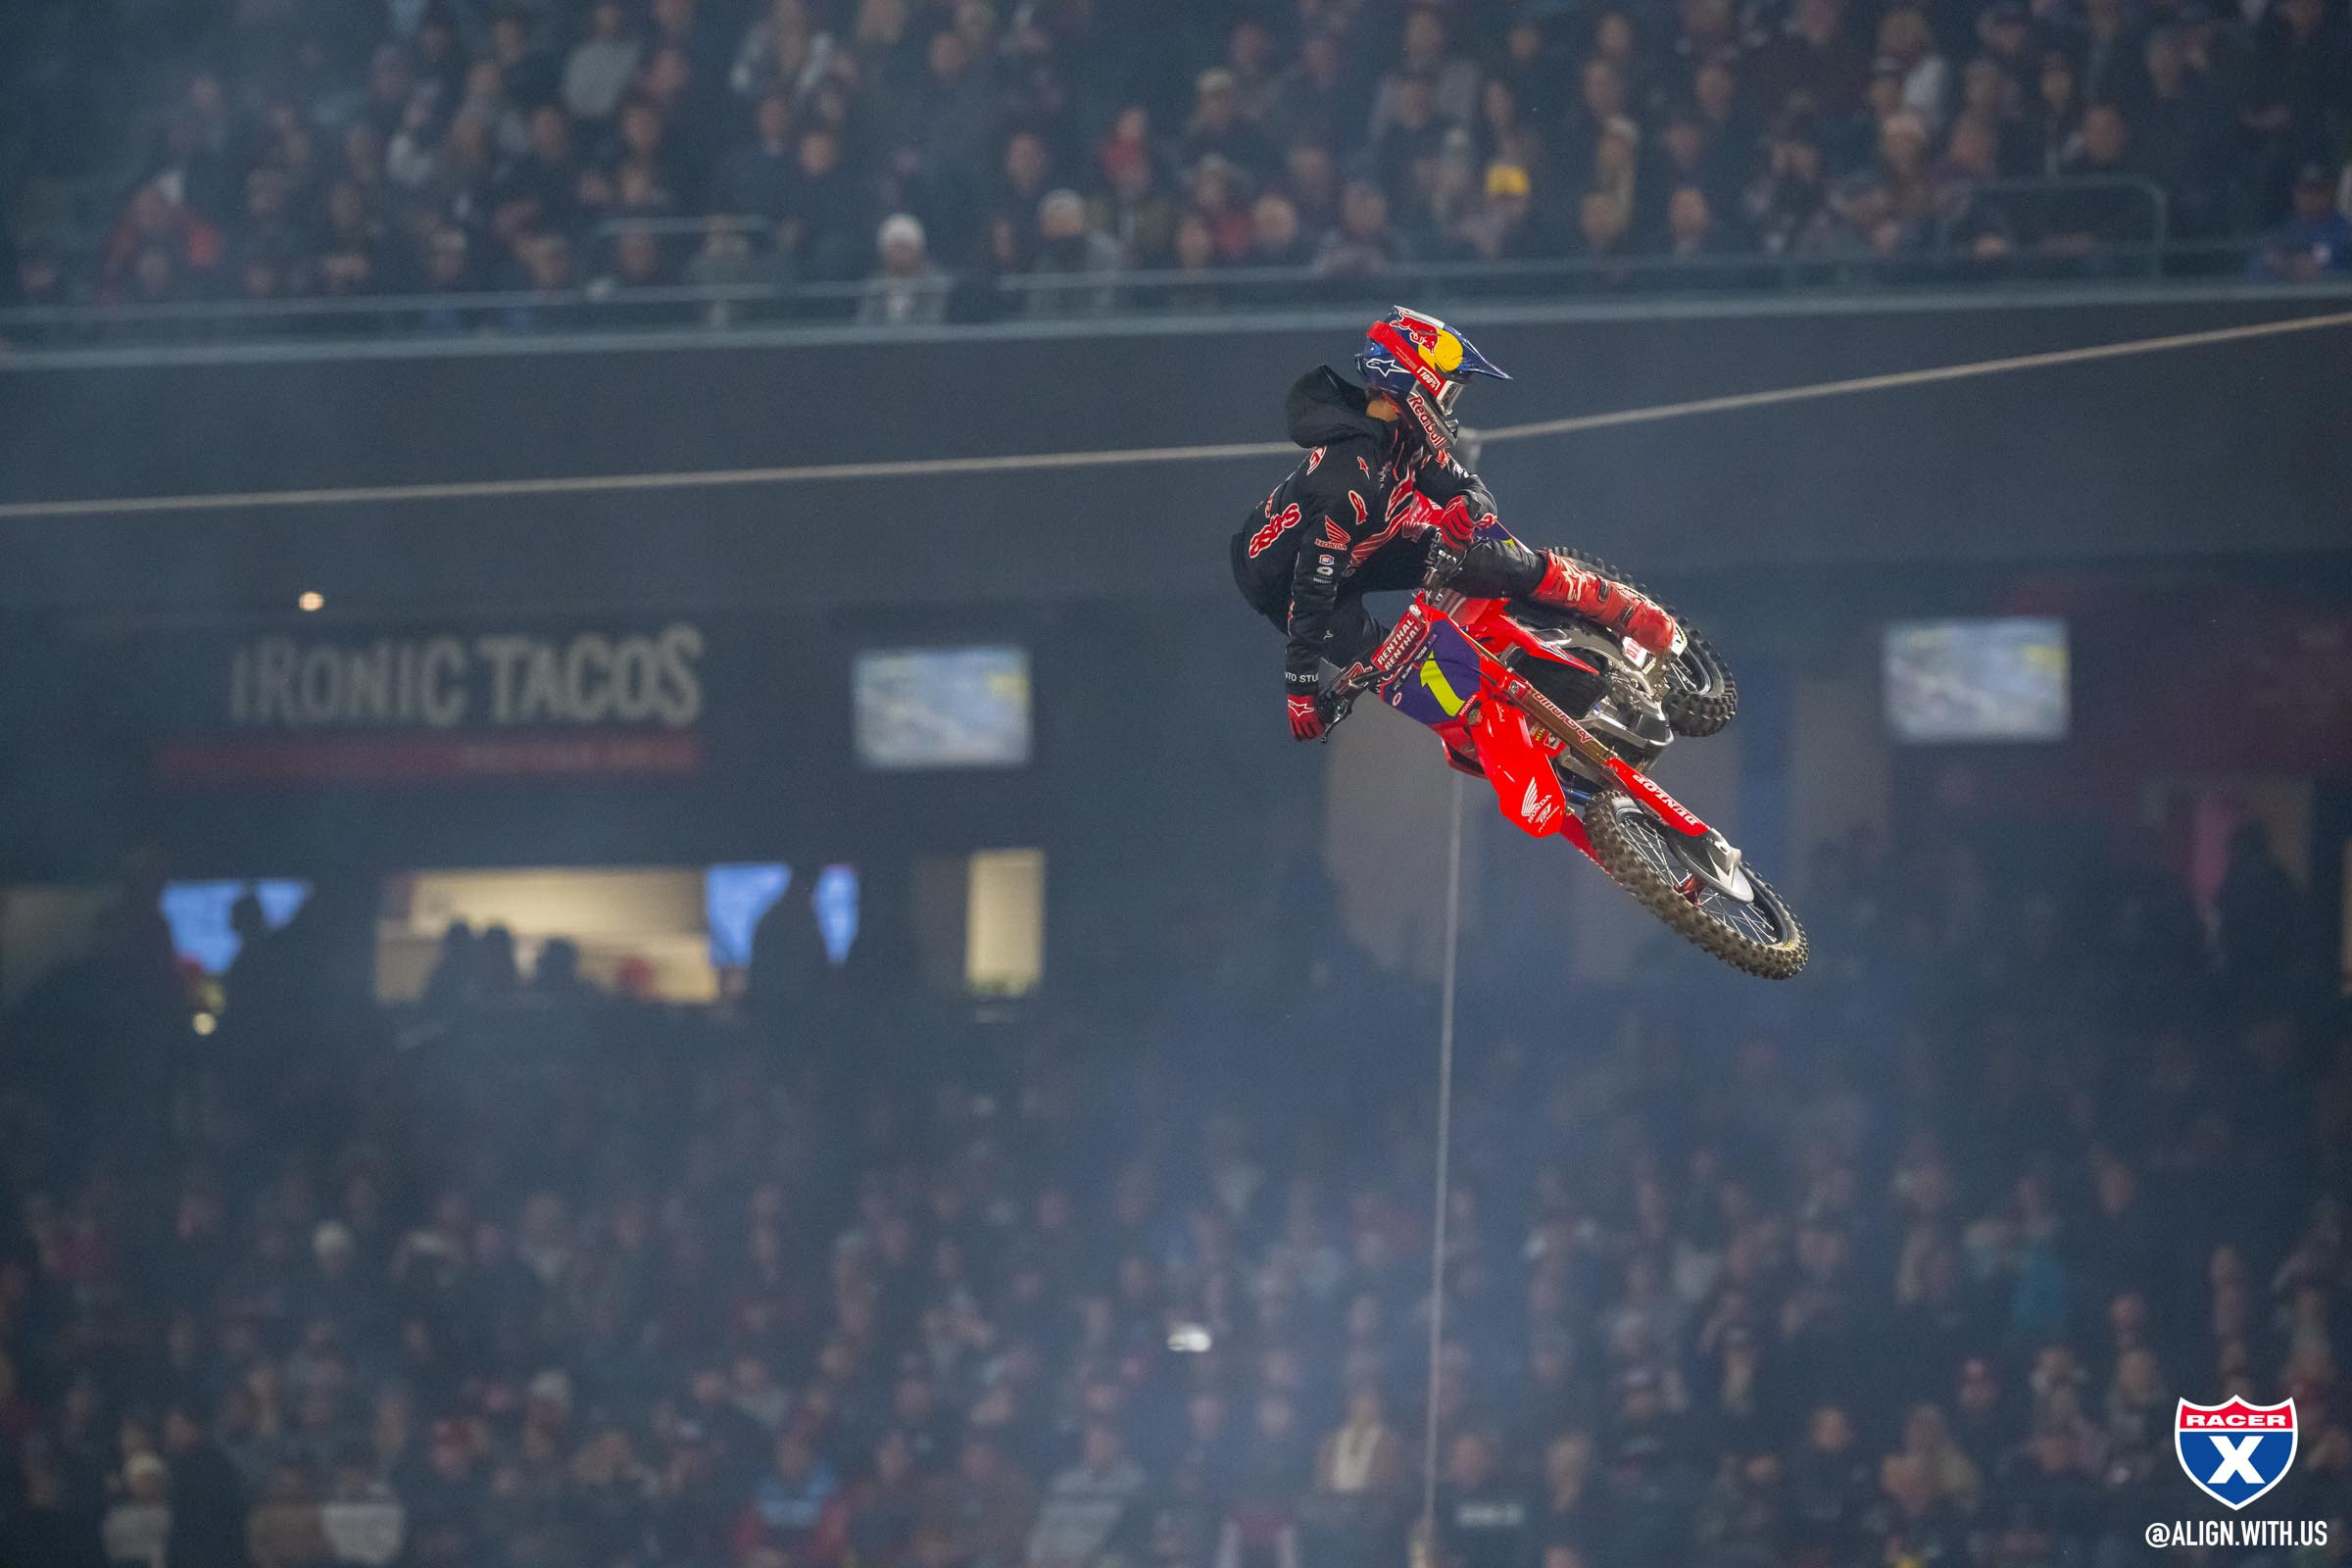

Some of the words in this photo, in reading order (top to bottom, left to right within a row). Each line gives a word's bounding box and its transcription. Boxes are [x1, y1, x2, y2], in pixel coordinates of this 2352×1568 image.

[1419, 370, 1439, 389] 100%
[1314, 538, 1348, 551] HONDA
[1377, 618, 1415, 665] RENTHAL
[1384, 625, 1421, 670] RENTHAL
[229, 638, 468, 727] IRONIC
[477, 625, 703, 727] TACOS
[1420, 651, 1466, 716] 1
[1459, 695, 1478, 716] HONDA
[1528, 795, 1553, 824] HONDA
[1632, 774, 1695, 826] DUNLOP
